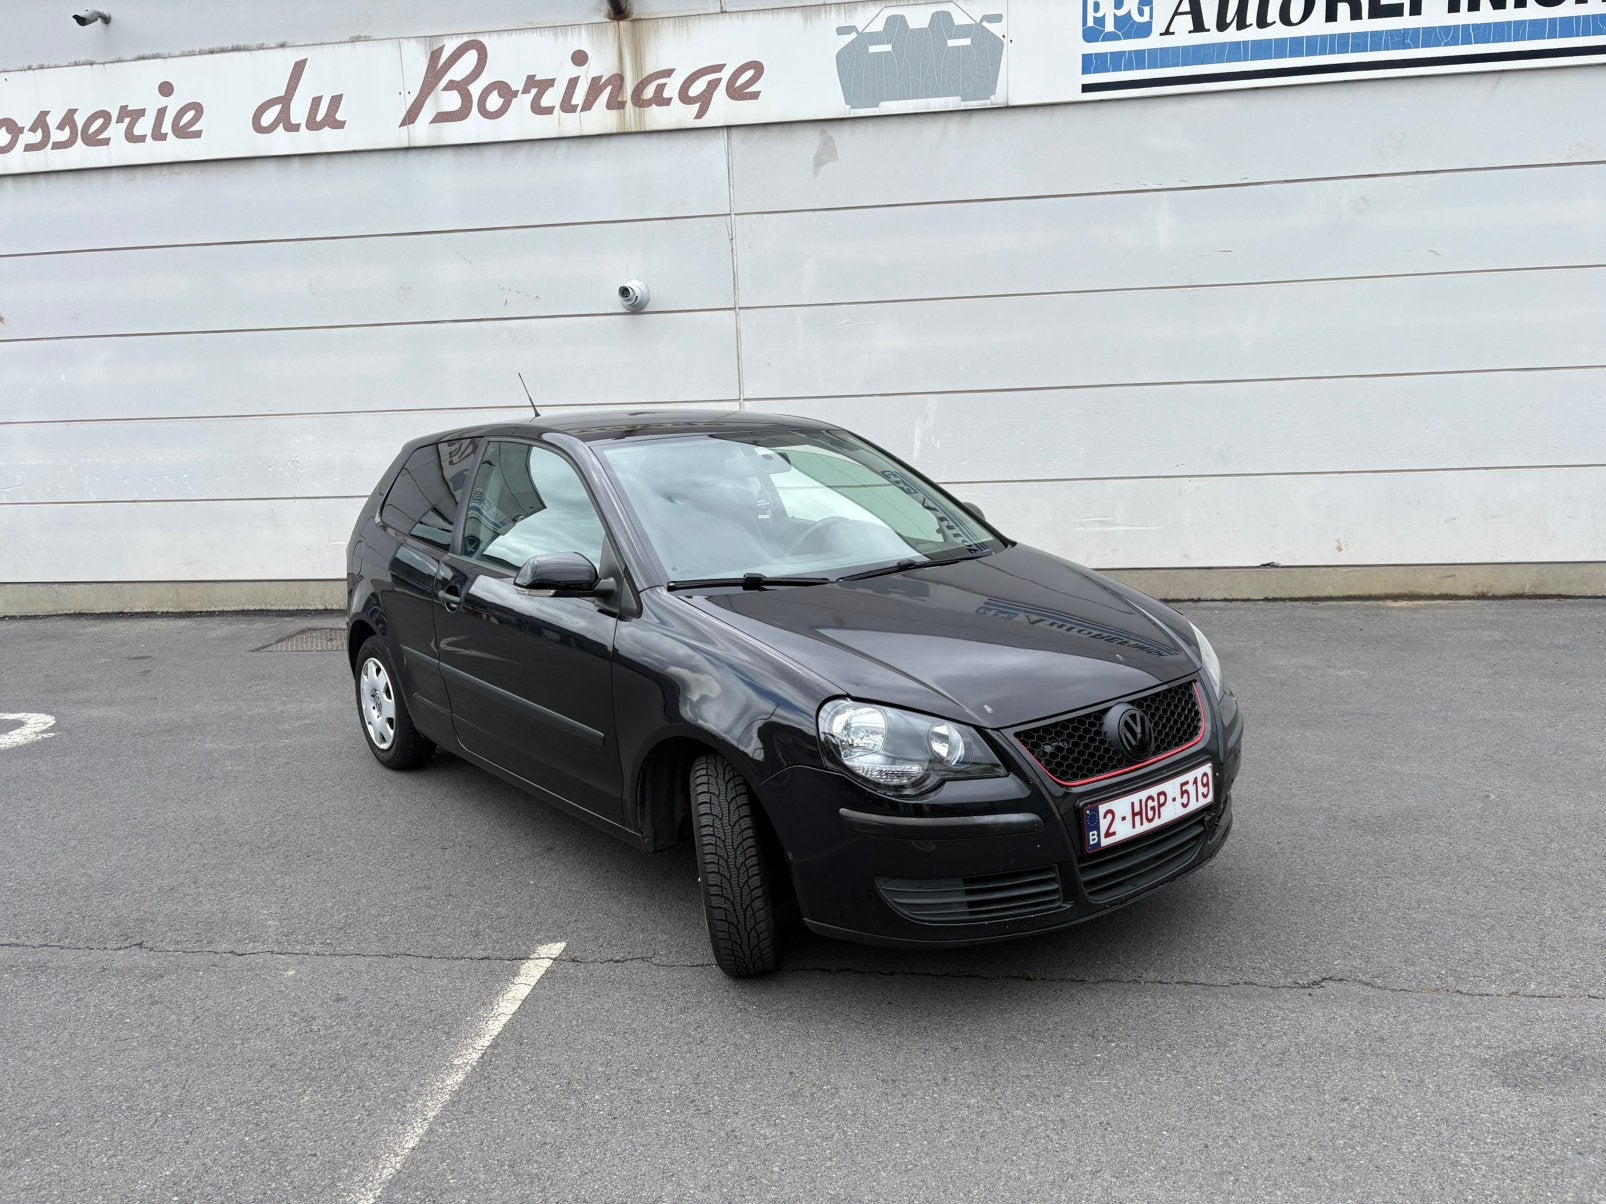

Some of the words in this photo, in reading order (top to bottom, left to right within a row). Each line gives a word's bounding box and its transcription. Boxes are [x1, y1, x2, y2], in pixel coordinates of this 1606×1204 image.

[252, 58, 347, 135] du
[398, 39, 765, 128] Borinage
[1089, 830, 1098, 845] B
[1103, 772, 1210, 839] 2-HGP-519
